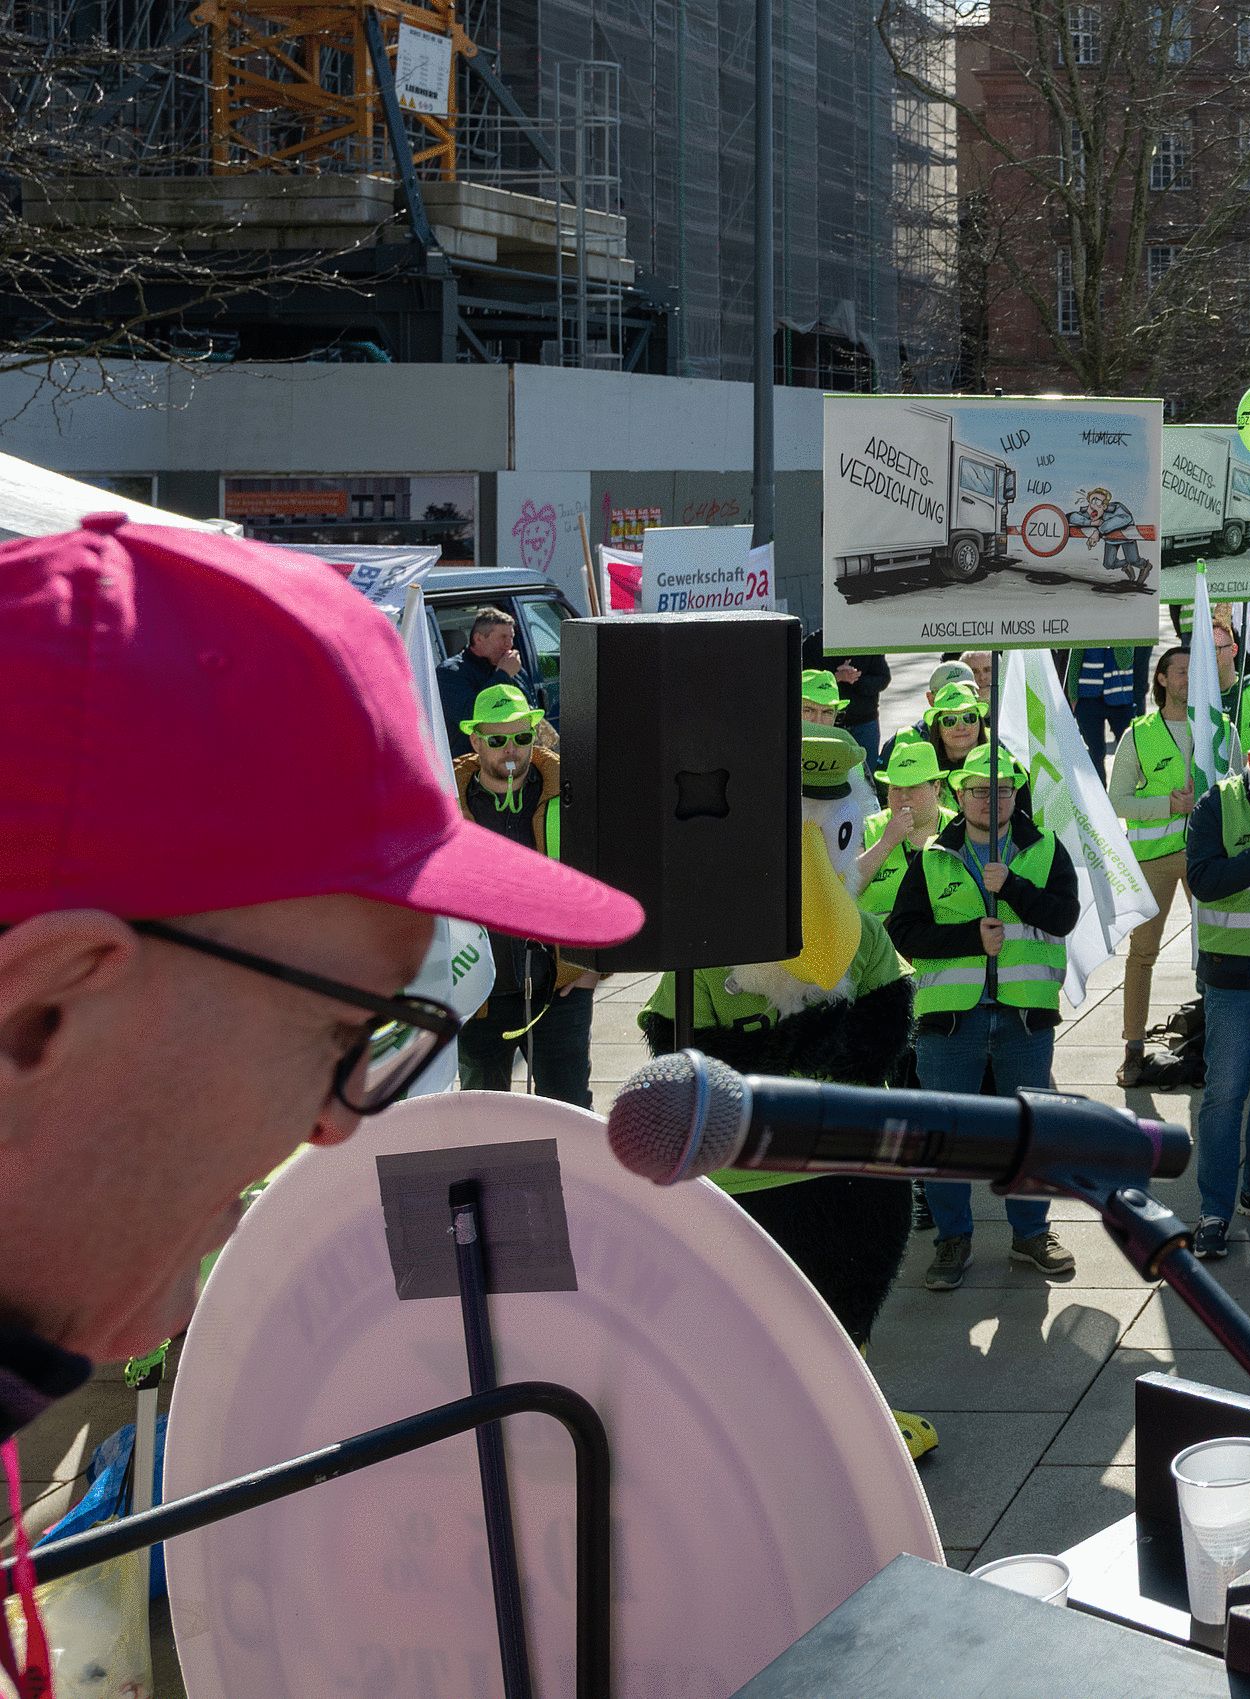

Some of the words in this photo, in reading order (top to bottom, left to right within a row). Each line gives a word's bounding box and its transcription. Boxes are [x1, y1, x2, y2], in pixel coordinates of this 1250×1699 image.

[864, 436, 934, 486] ARBEITS-
[1172, 454, 1216, 489] ARBEITS-
[840, 453, 945, 524] VERDICHTUNG
[1028, 522, 1061, 538] ZOLL
[657, 566, 744, 588] Gewerkschaft
[921, 620, 994, 638] AUSGLEICH
[1001, 619, 1035, 636] MUSS
[1043, 618, 1070, 634] HER
[802, 759, 840, 772] OLL
